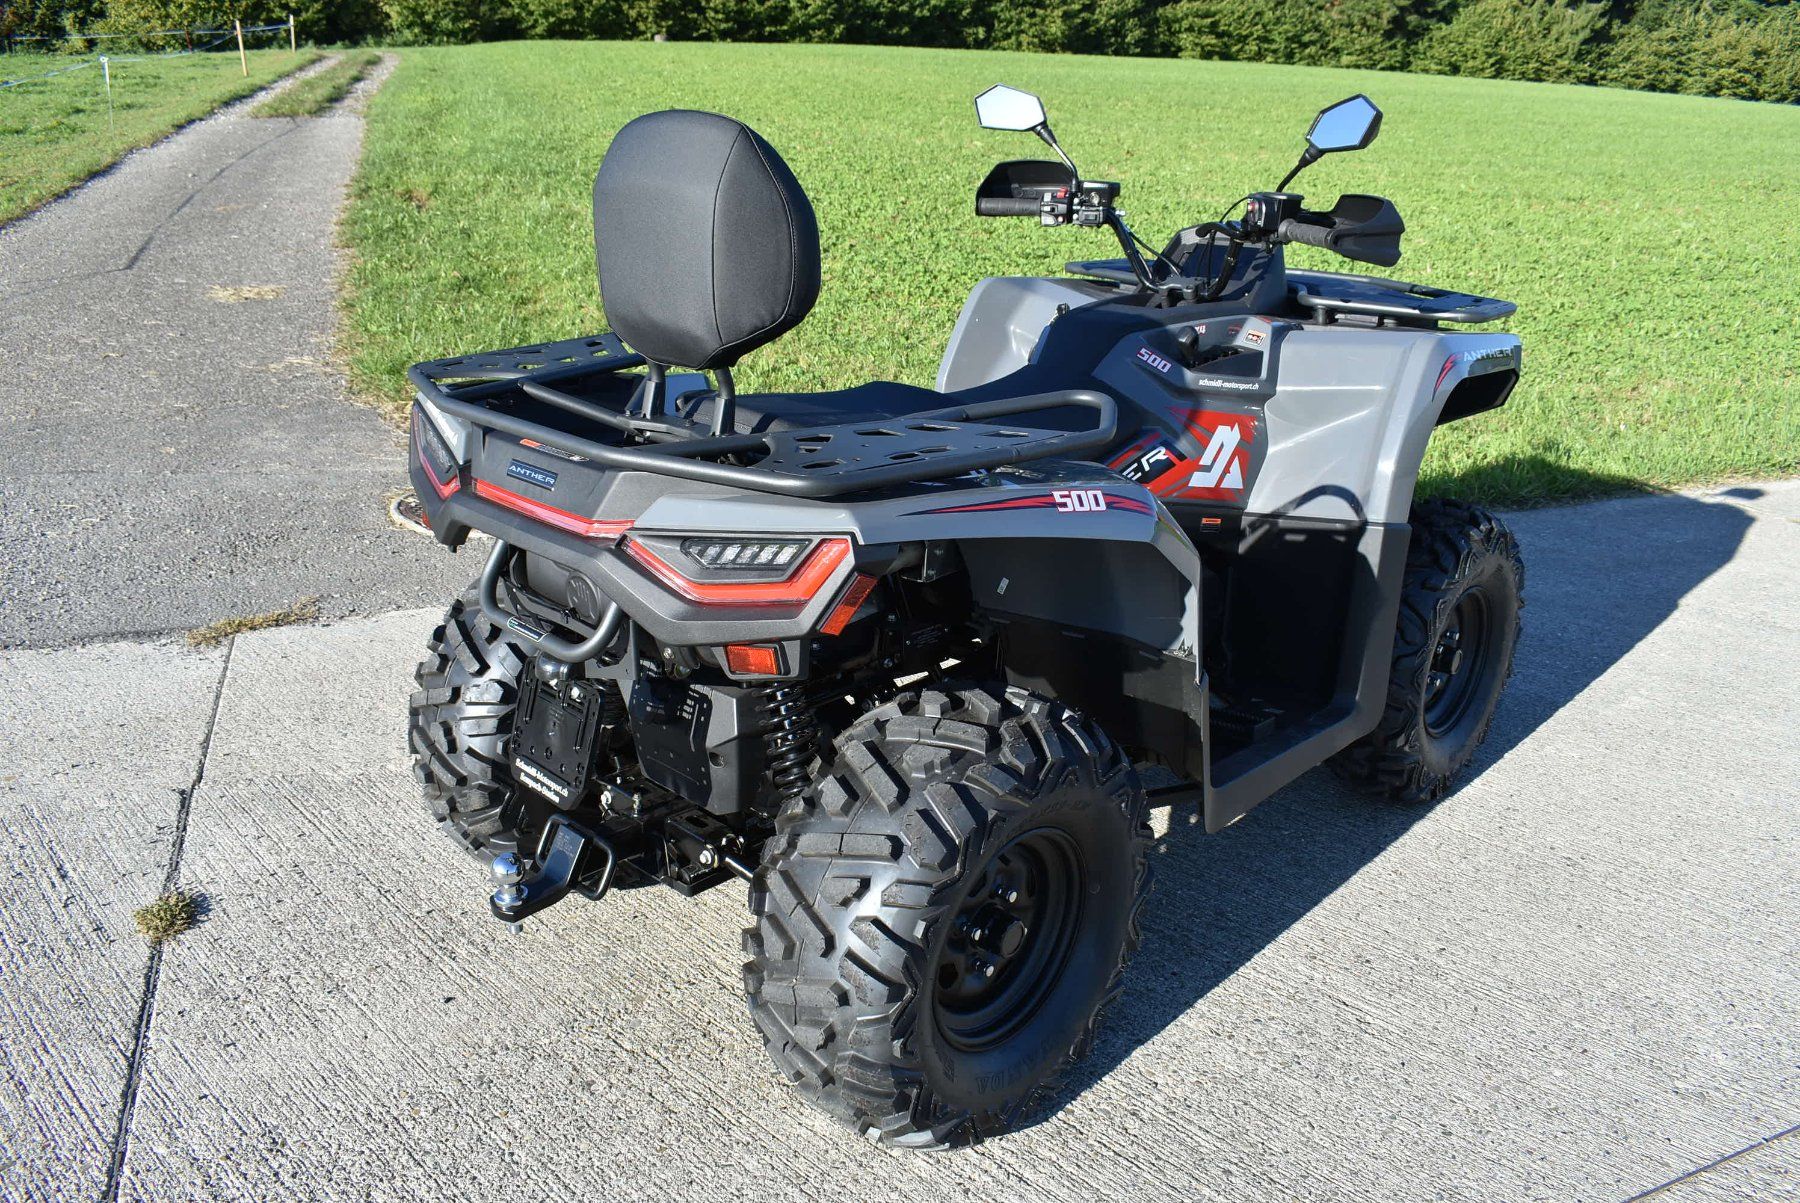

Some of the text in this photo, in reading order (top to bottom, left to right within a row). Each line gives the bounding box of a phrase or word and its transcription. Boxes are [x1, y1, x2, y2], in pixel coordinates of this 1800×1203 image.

[1136, 347, 1173, 374] 500
[1463, 347, 1513, 362] ANTHER
[508, 464, 556, 485] ANTHER
[1051, 490, 1107, 512] 500
